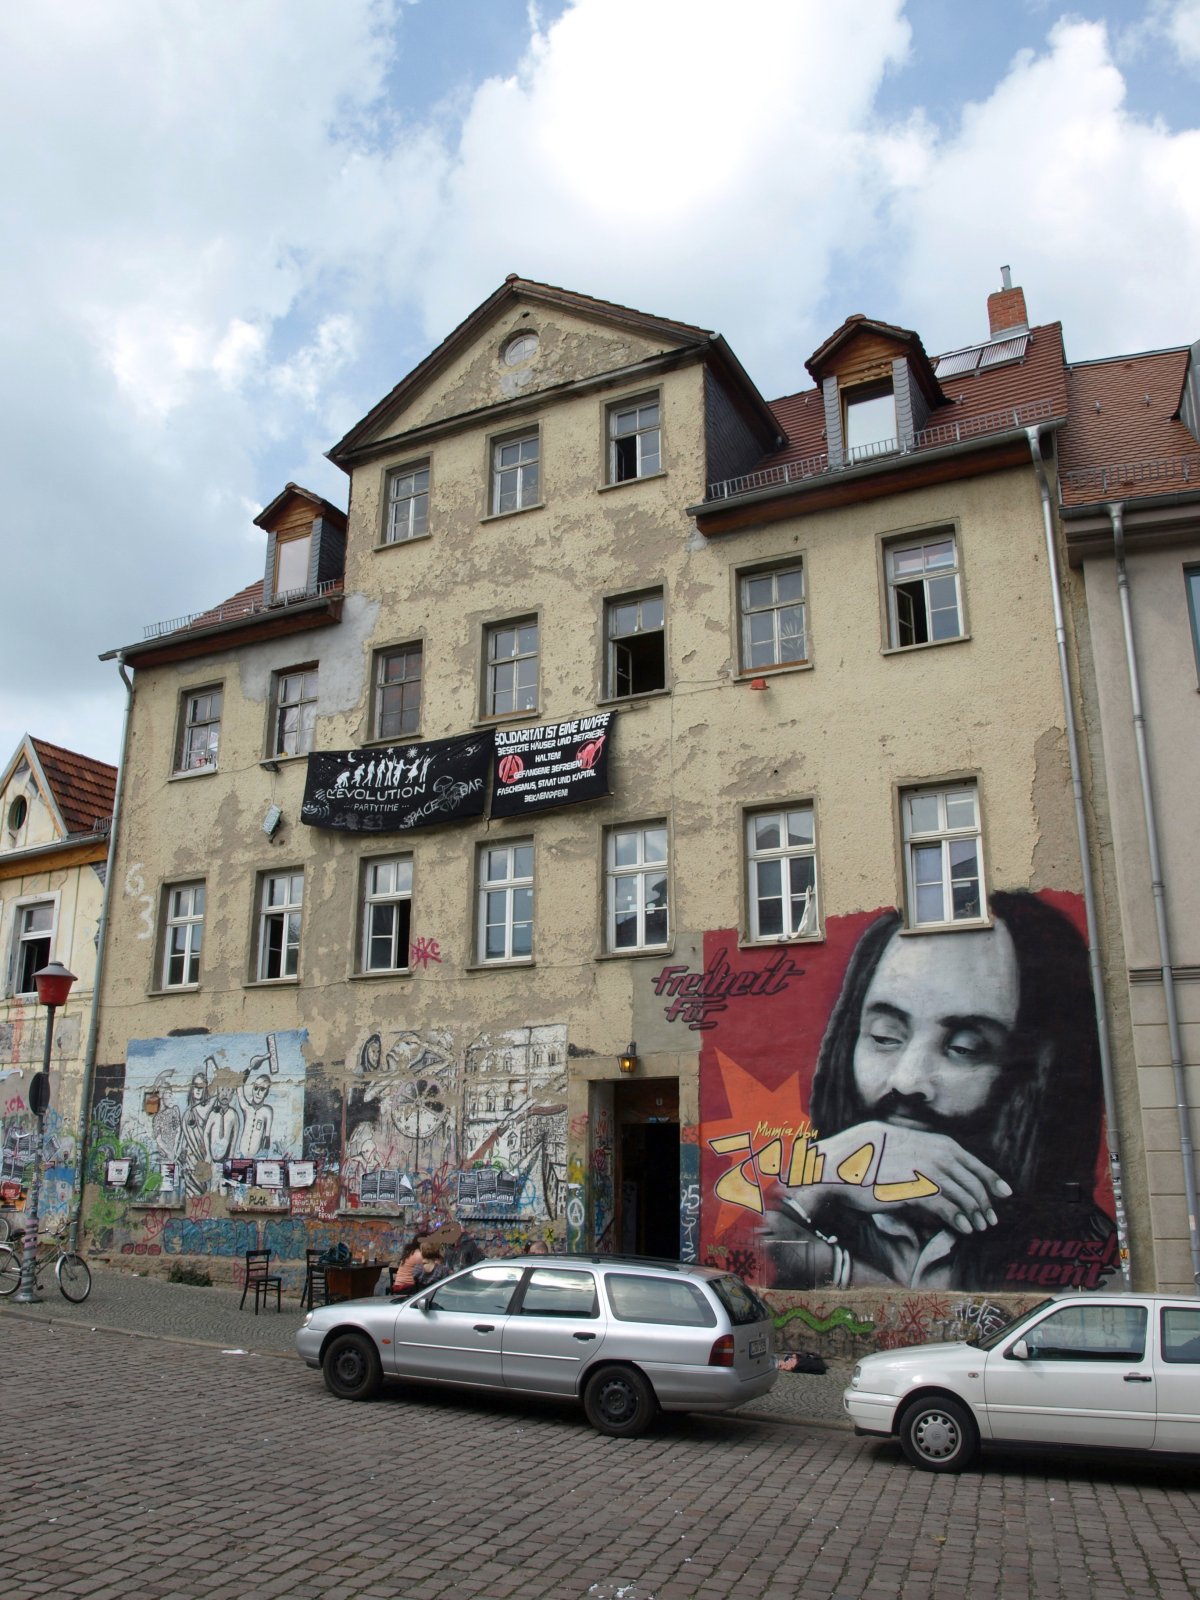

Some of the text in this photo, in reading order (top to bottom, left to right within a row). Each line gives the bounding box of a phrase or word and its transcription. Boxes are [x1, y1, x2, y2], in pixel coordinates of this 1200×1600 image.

[545, 726, 557, 738] IST
[558, 720, 579, 735] EINE
[580, 712, 611, 731] WAFFE
[497, 743, 529, 756] BESETZTE
[557, 735, 571, 746] UND
[572, 728, 605, 743] BETRIEBE
[534, 751, 561, 763] HALTEN!
[513, 765, 550, 780] GEFANGENE
[538, 777, 556, 789] STAAT
[557, 774, 571, 784] UND
[572, 769, 596, 782] KAPITAL
[326, 783, 426, 801] REVOLUTION
[459, 777, 485, 796] BAR
[524, 788, 569, 803] BEKAEMPFEN!
[353, 803, 400, 812] PARTYTIME
[753, 1120, 819, 1143] Mumia Abu
